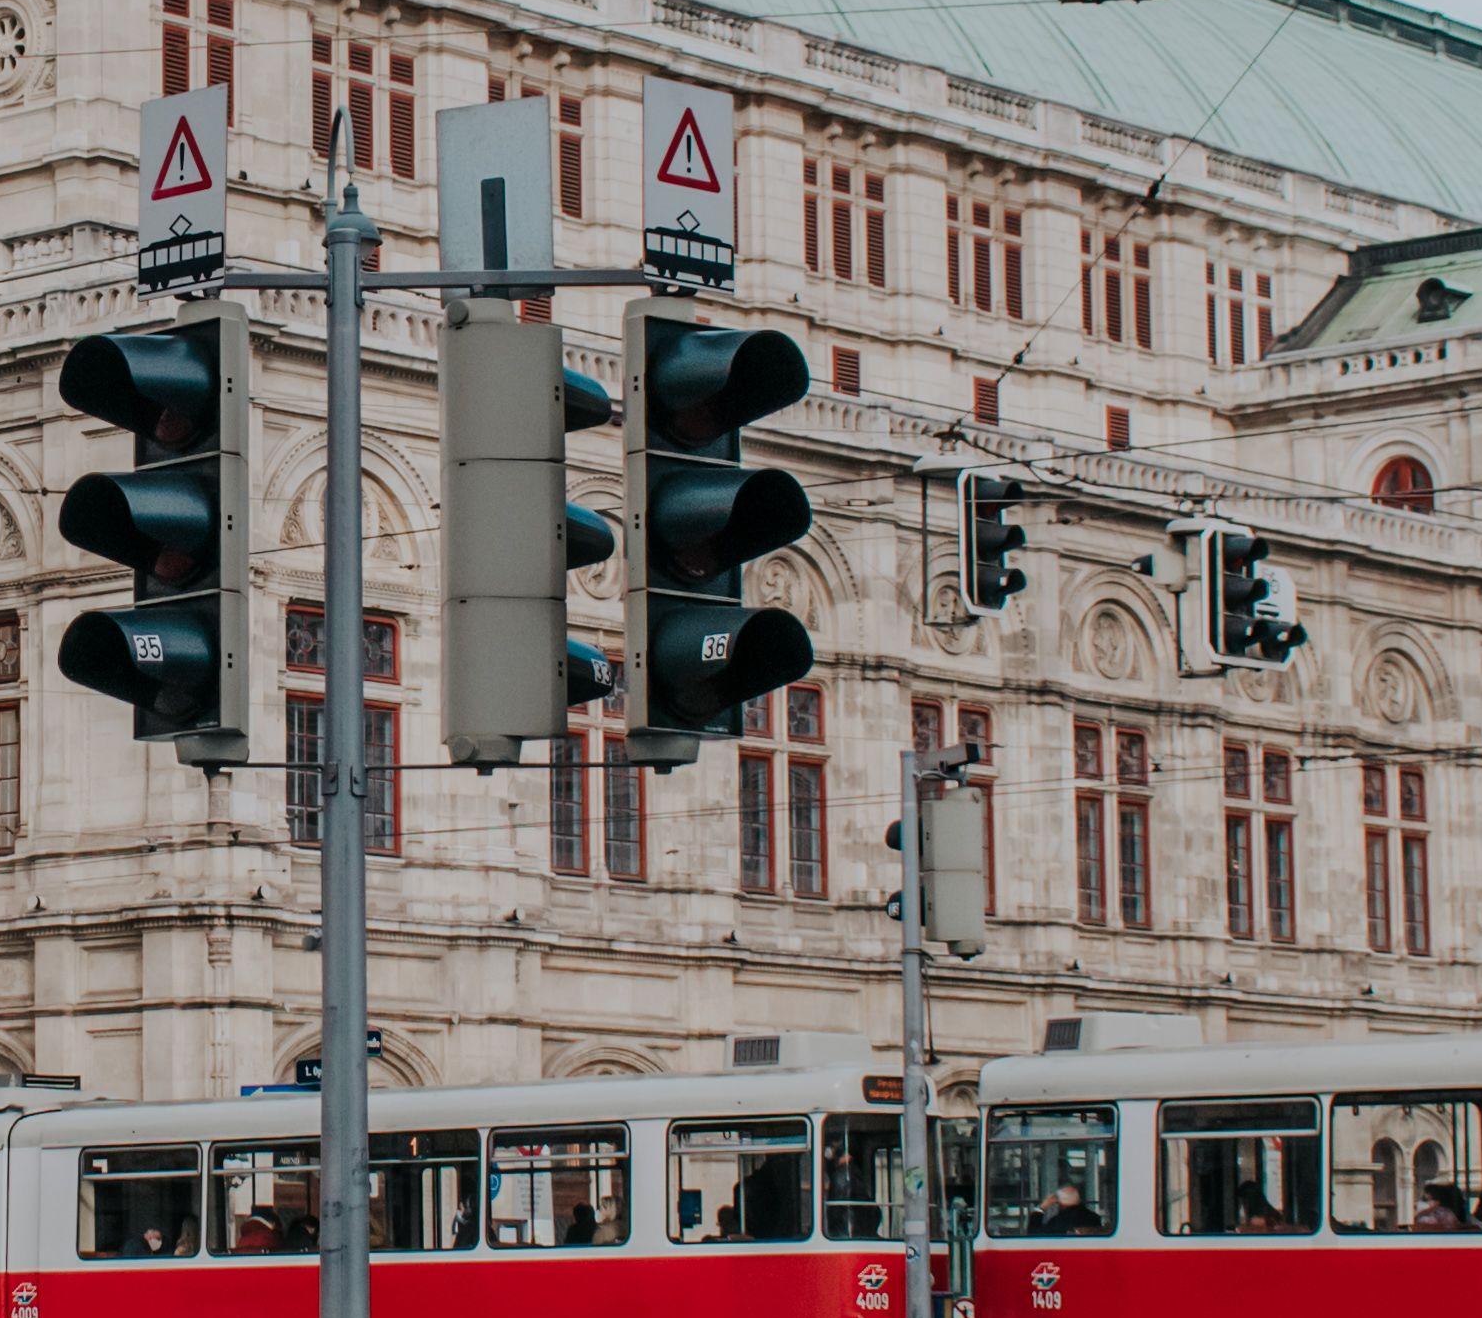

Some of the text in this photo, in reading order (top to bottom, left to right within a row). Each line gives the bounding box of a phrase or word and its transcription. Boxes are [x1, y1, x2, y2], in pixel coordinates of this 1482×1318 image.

[136, 636, 161, 659] 35
[703, 635, 727, 659] 36
[593, 660, 611, 684] 33
[409, 1136, 418, 1157] 1
[856, 1292, 889, 1310] 4009
[1031, 1290, 1062, 1309] 1409
